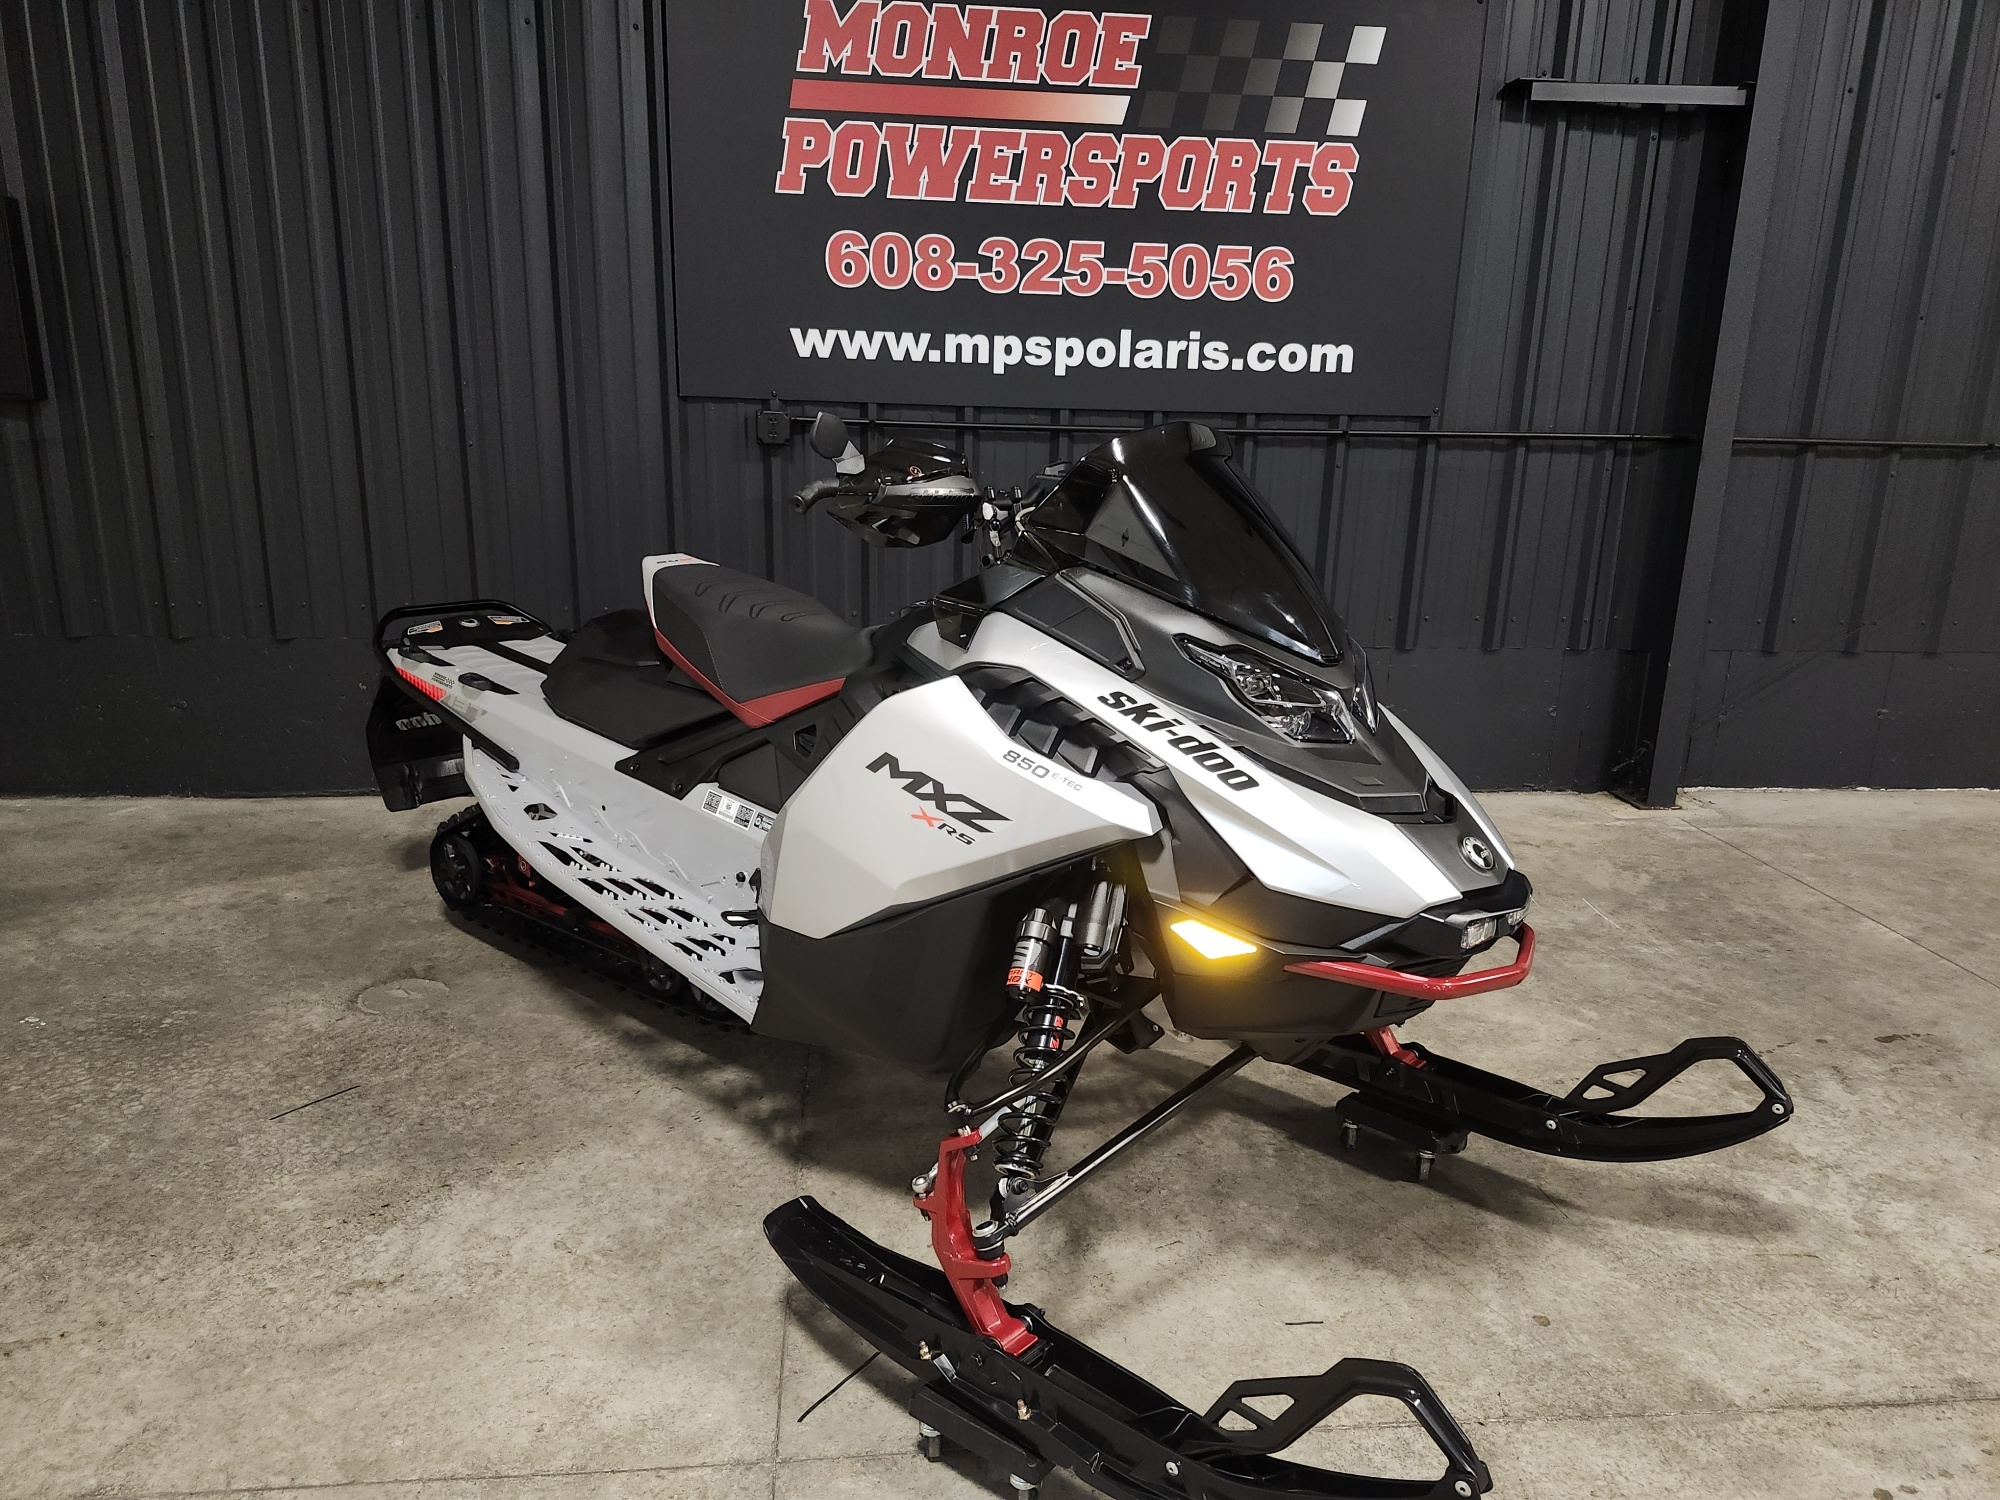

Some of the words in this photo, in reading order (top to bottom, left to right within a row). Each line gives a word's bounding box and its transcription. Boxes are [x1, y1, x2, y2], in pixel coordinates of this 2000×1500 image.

[796, 0, 1152, 88] MONROE
[775, 117, 1360, 217] POWERSPORTS
[825, 229, 1295, 303] 608-325-5056
[789, 327, 1354, 377] www.mpspolaris.com
[1002, 749, 1050, 779] 850
[1051, 772, 1083, 791] E-TEC
[1097, 690, 1260, 791] ski-doo
[865, 752, 1013, 833] MXZ
